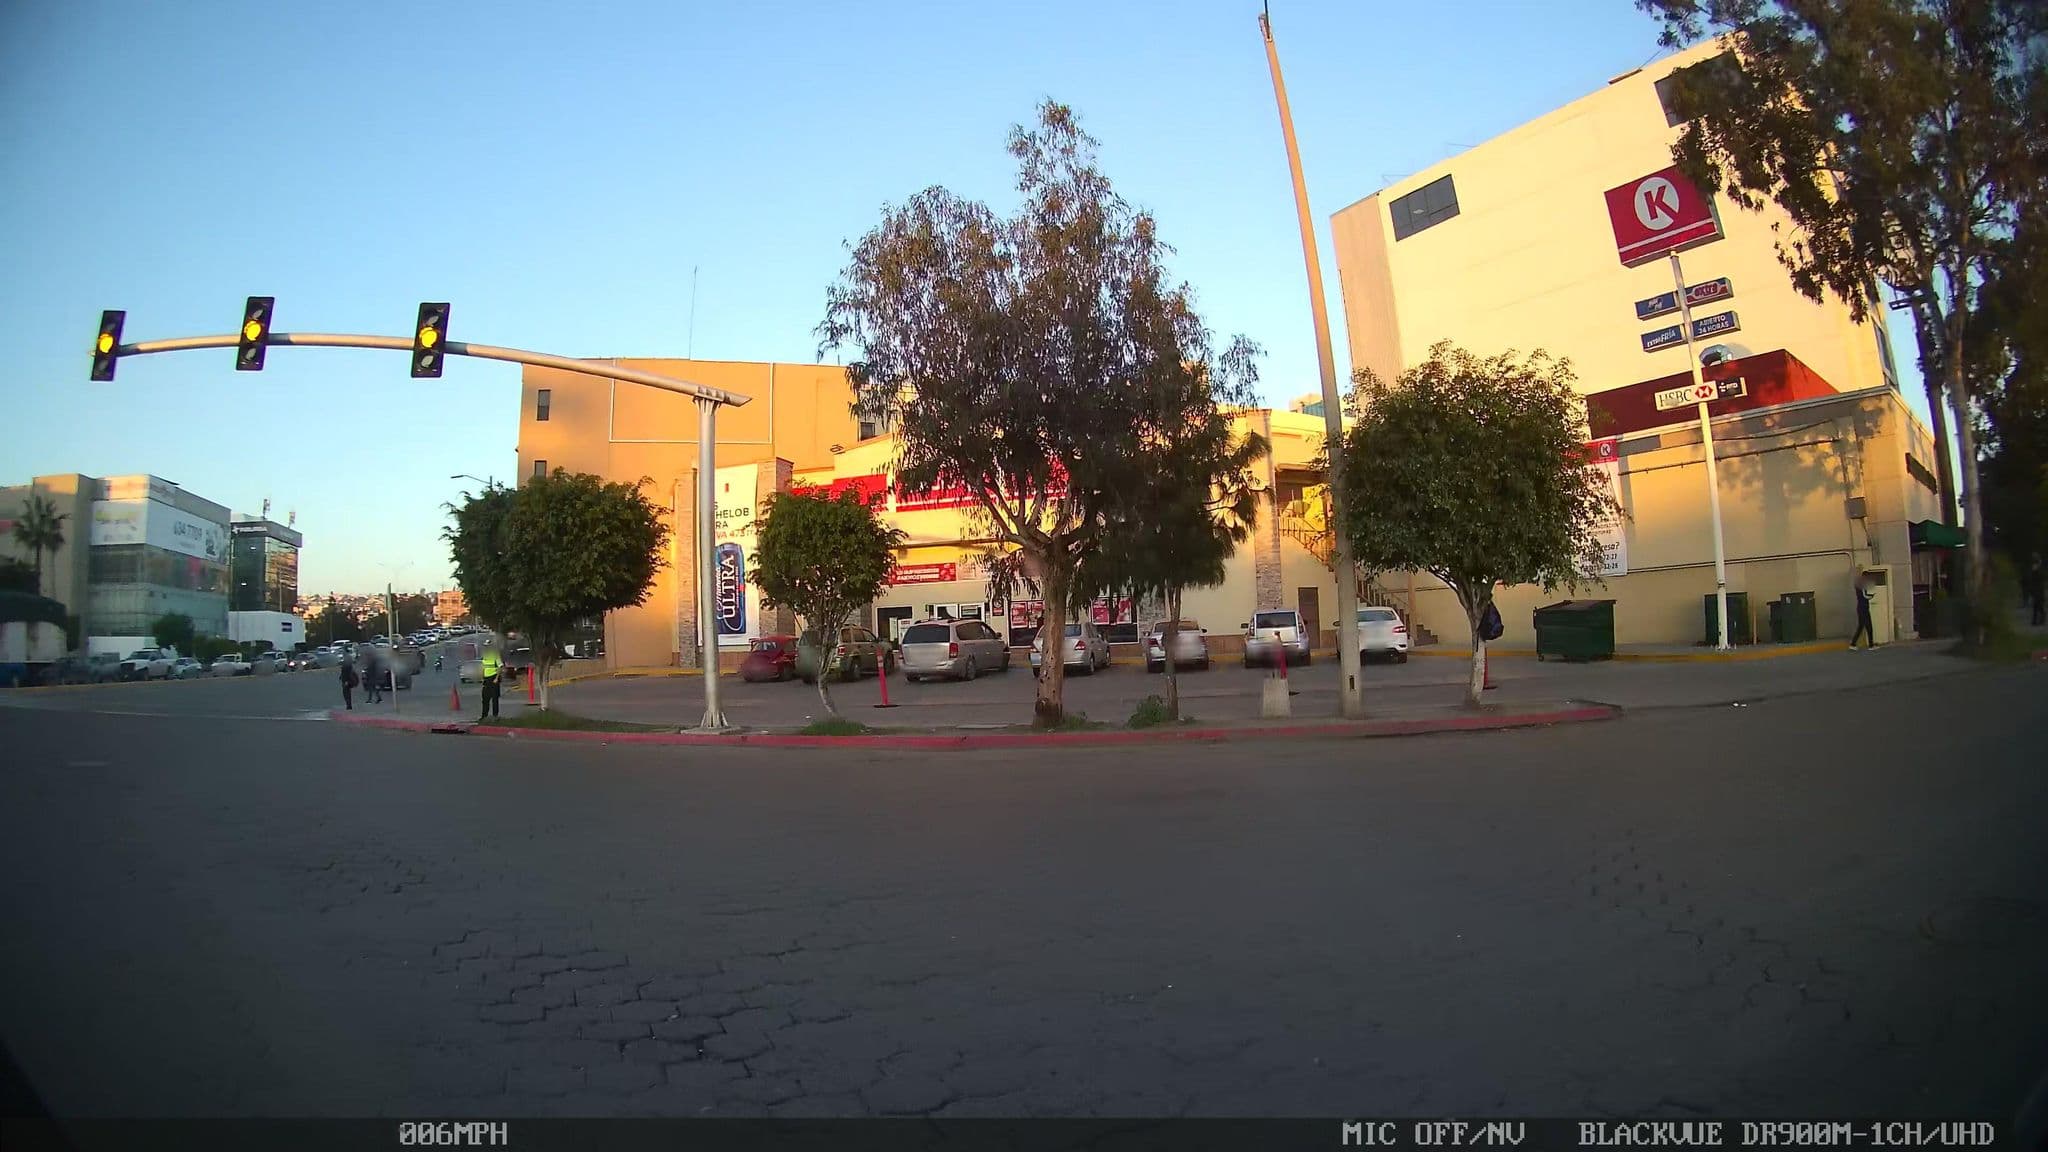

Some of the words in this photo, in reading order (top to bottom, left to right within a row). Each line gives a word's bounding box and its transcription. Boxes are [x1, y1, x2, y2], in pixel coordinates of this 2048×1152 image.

[1707, 321, 1729, 332] HORAS
[1659, 389, 1692, 407] HSBC
[715, 507, 750, 520] HELOB
[722, 555, 736, 618] ULTRA
